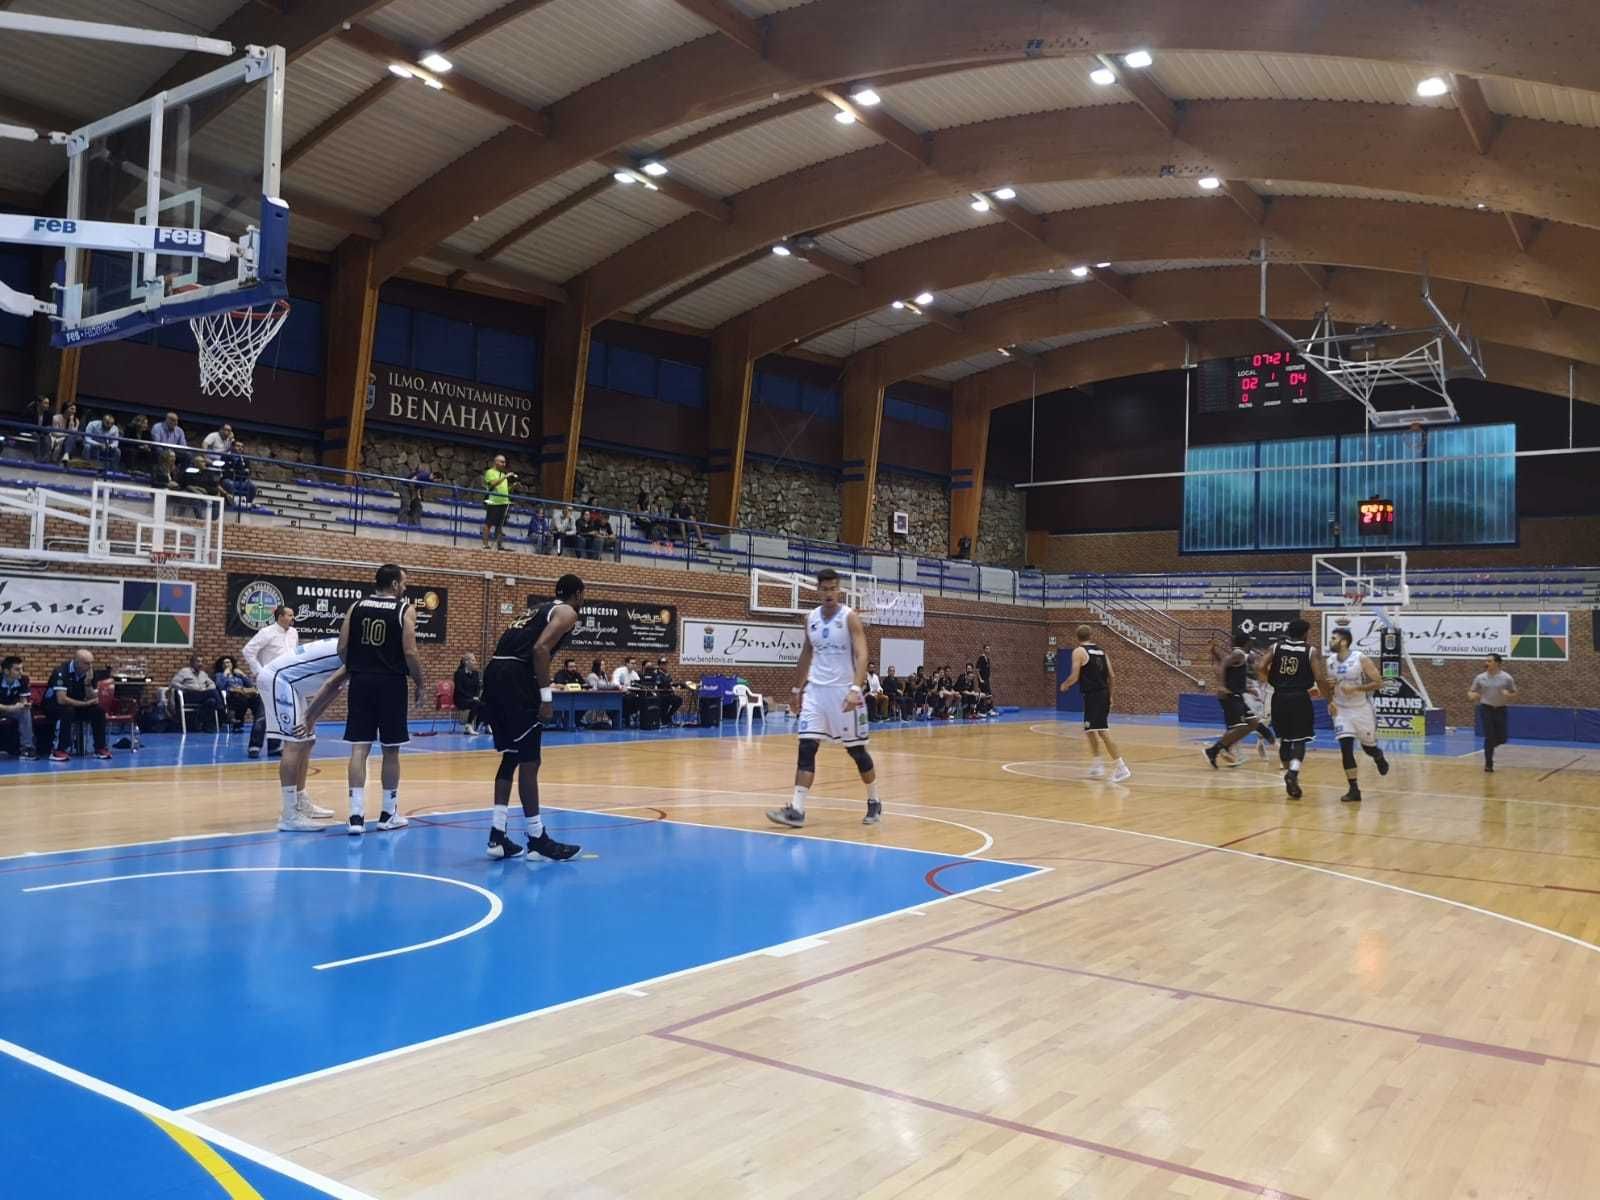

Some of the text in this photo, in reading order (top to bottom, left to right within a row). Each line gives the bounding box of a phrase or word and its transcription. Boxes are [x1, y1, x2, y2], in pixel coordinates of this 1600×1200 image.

[1242, 377, 1259, 390] 02
[1290, 372, 1308, 385] 04
[389, 372, 532, 411] ILMO. AYUNTAMIENTO
[389, 393, 532, 438] BENAHAVIS
[296, 586, 362, 599] BALONCESTO
[55, 624, 114, 635] Natural
[361, 617, 387, 646] 10
